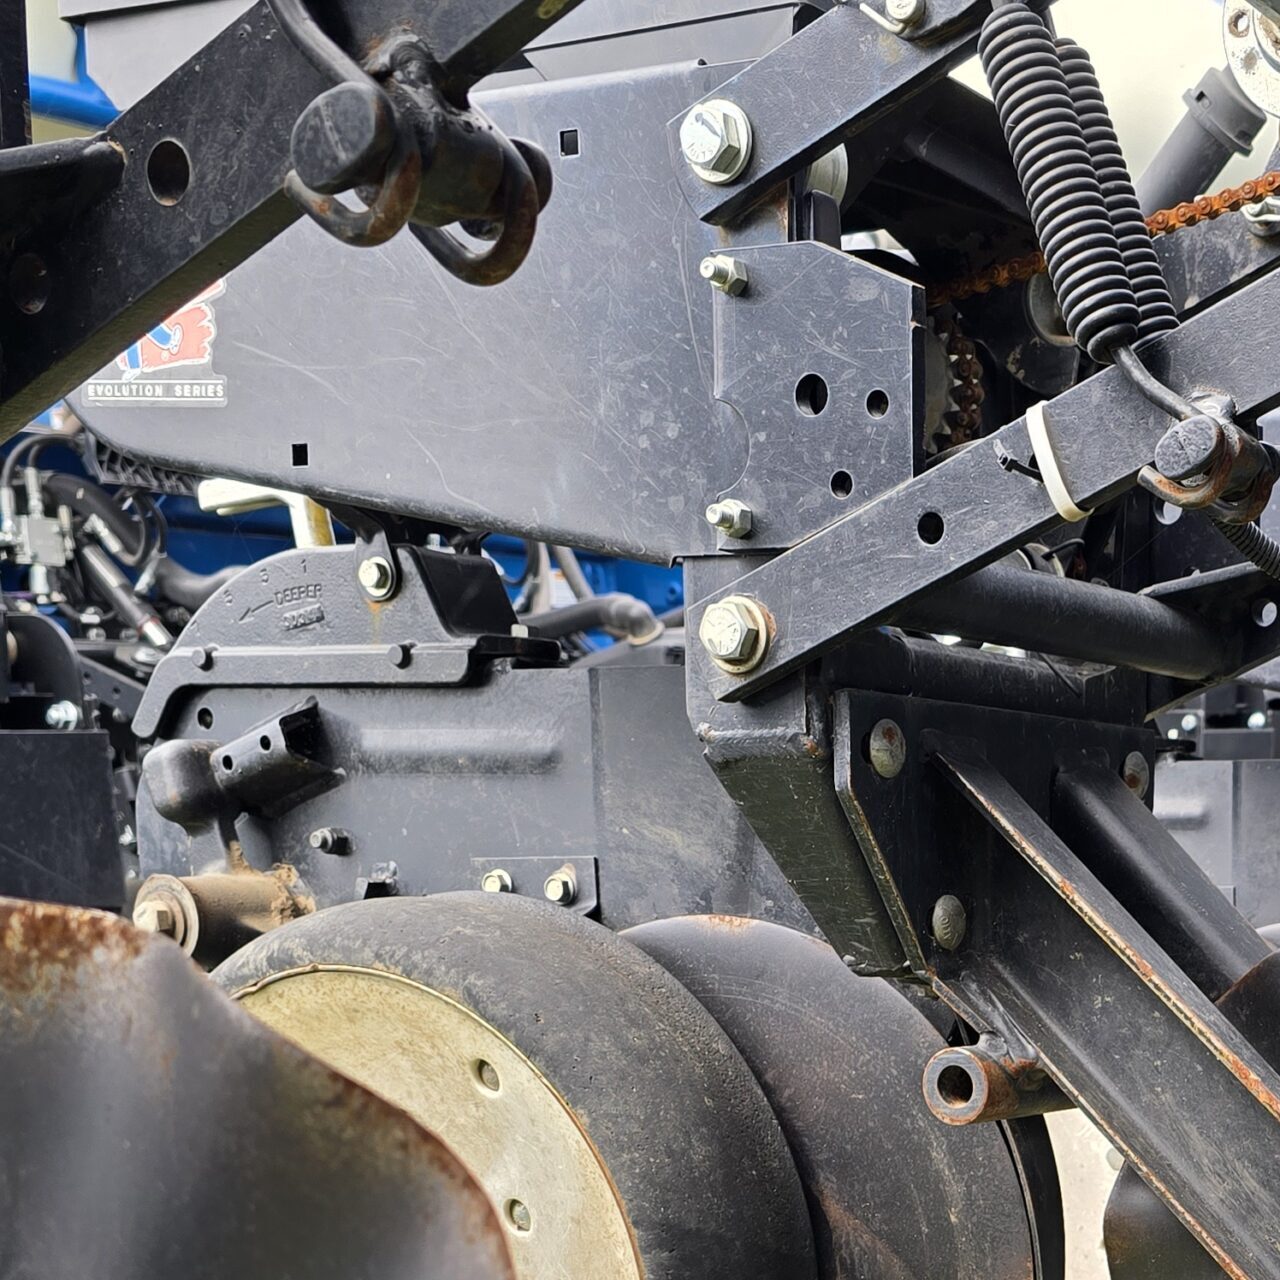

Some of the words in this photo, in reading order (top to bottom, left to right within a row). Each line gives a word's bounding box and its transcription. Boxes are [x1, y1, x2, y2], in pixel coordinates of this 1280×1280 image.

[87, 384, 163, 397] EVOLUTION
[174, 384, 225, 397] SERIES
[274, 583, 322, 606] DEEPER
